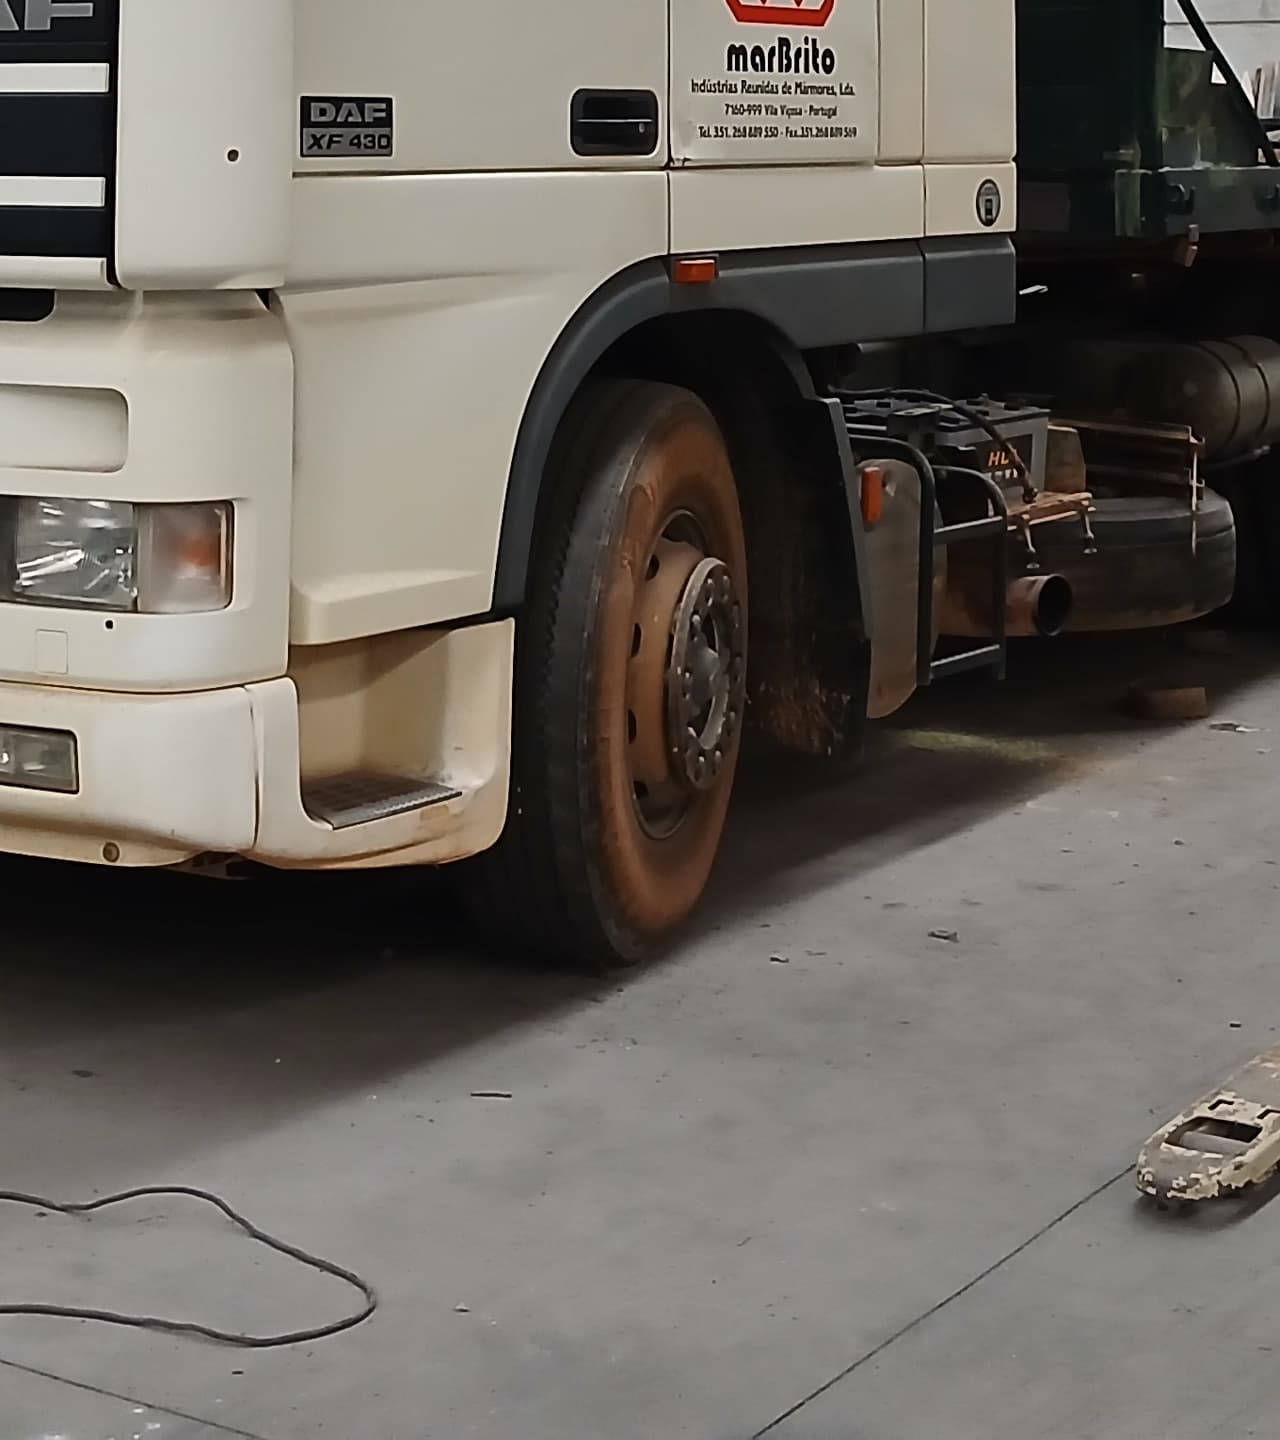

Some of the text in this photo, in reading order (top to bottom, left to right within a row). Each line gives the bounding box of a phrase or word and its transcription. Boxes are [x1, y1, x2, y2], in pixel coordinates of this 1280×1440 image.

[726, 36, 835, 75] marBrito
[740, 80, 779, 95] Reunidas
[781, 81, 792, 95] de
[310, 102, 387, 122] DAF
[764, 104, 778, 116] Vila
[809, 105, 837, 119] Portugal
[307, 133, 391, 150] XF 430
